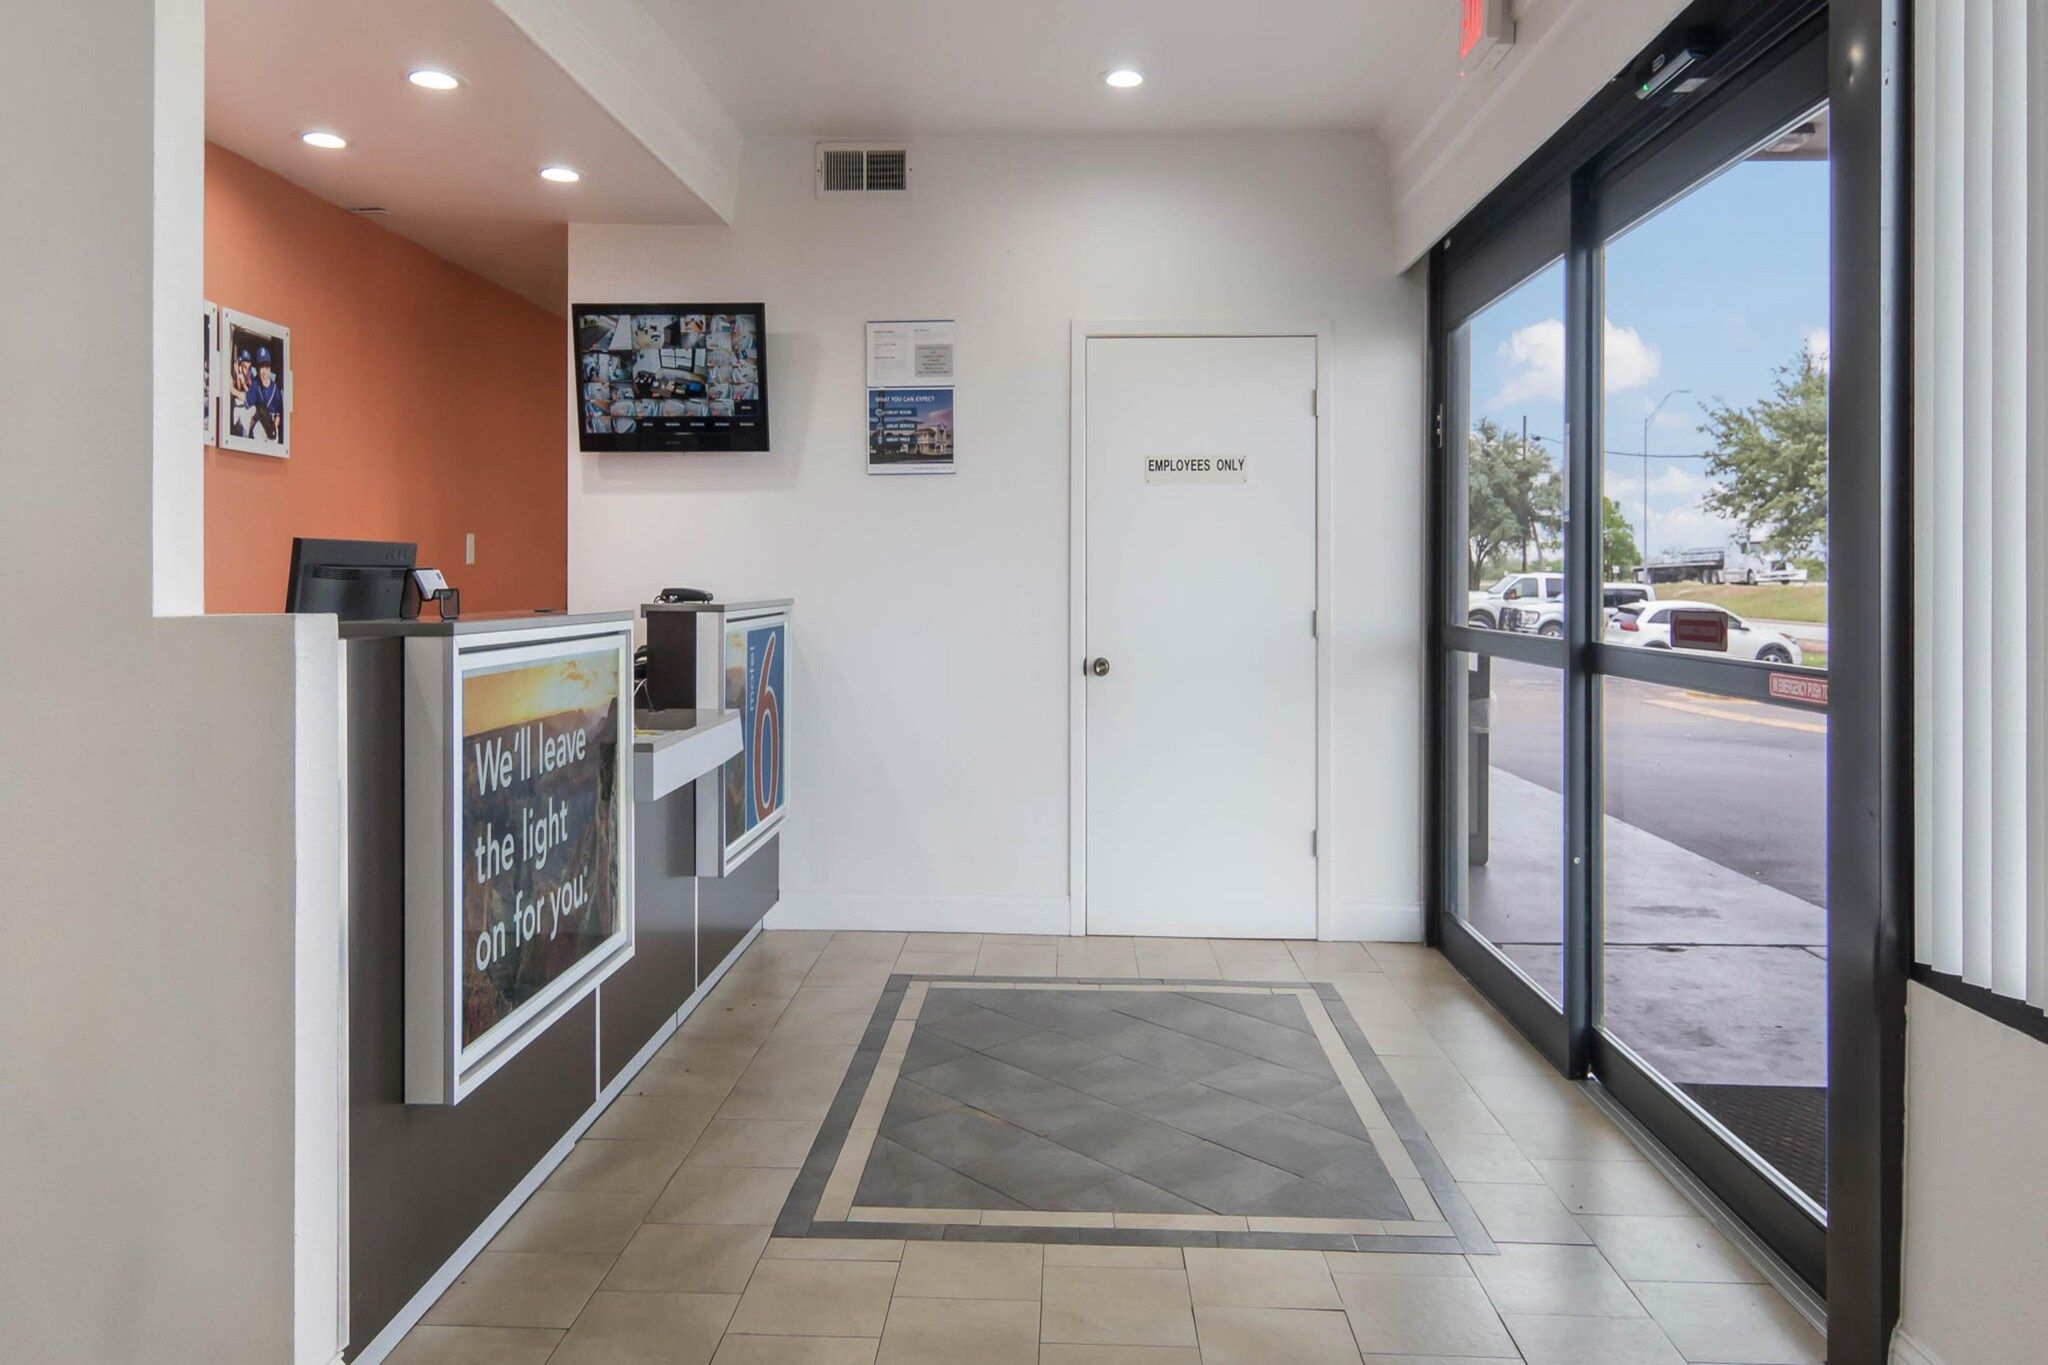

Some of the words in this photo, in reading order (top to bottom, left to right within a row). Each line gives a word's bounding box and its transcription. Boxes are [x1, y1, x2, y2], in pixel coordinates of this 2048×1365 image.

[1148, 459, 1211, 472] EMPLOYEES
[1216, 459, 1245, 471] ONLY
[753, 630, 779, 823] 6
[1778, 678, 1807, 697] EMERGENCY
[1807, 682, 1821, 699] PUSH
[475, 726, 531, 796] We'll
[539, 721, 586, 775] leave
[475, 822, 515, 884] the
[523, 796, 568, 870] light
[476, 921, 506, 971] on
[513, 890, 545, 948] for
